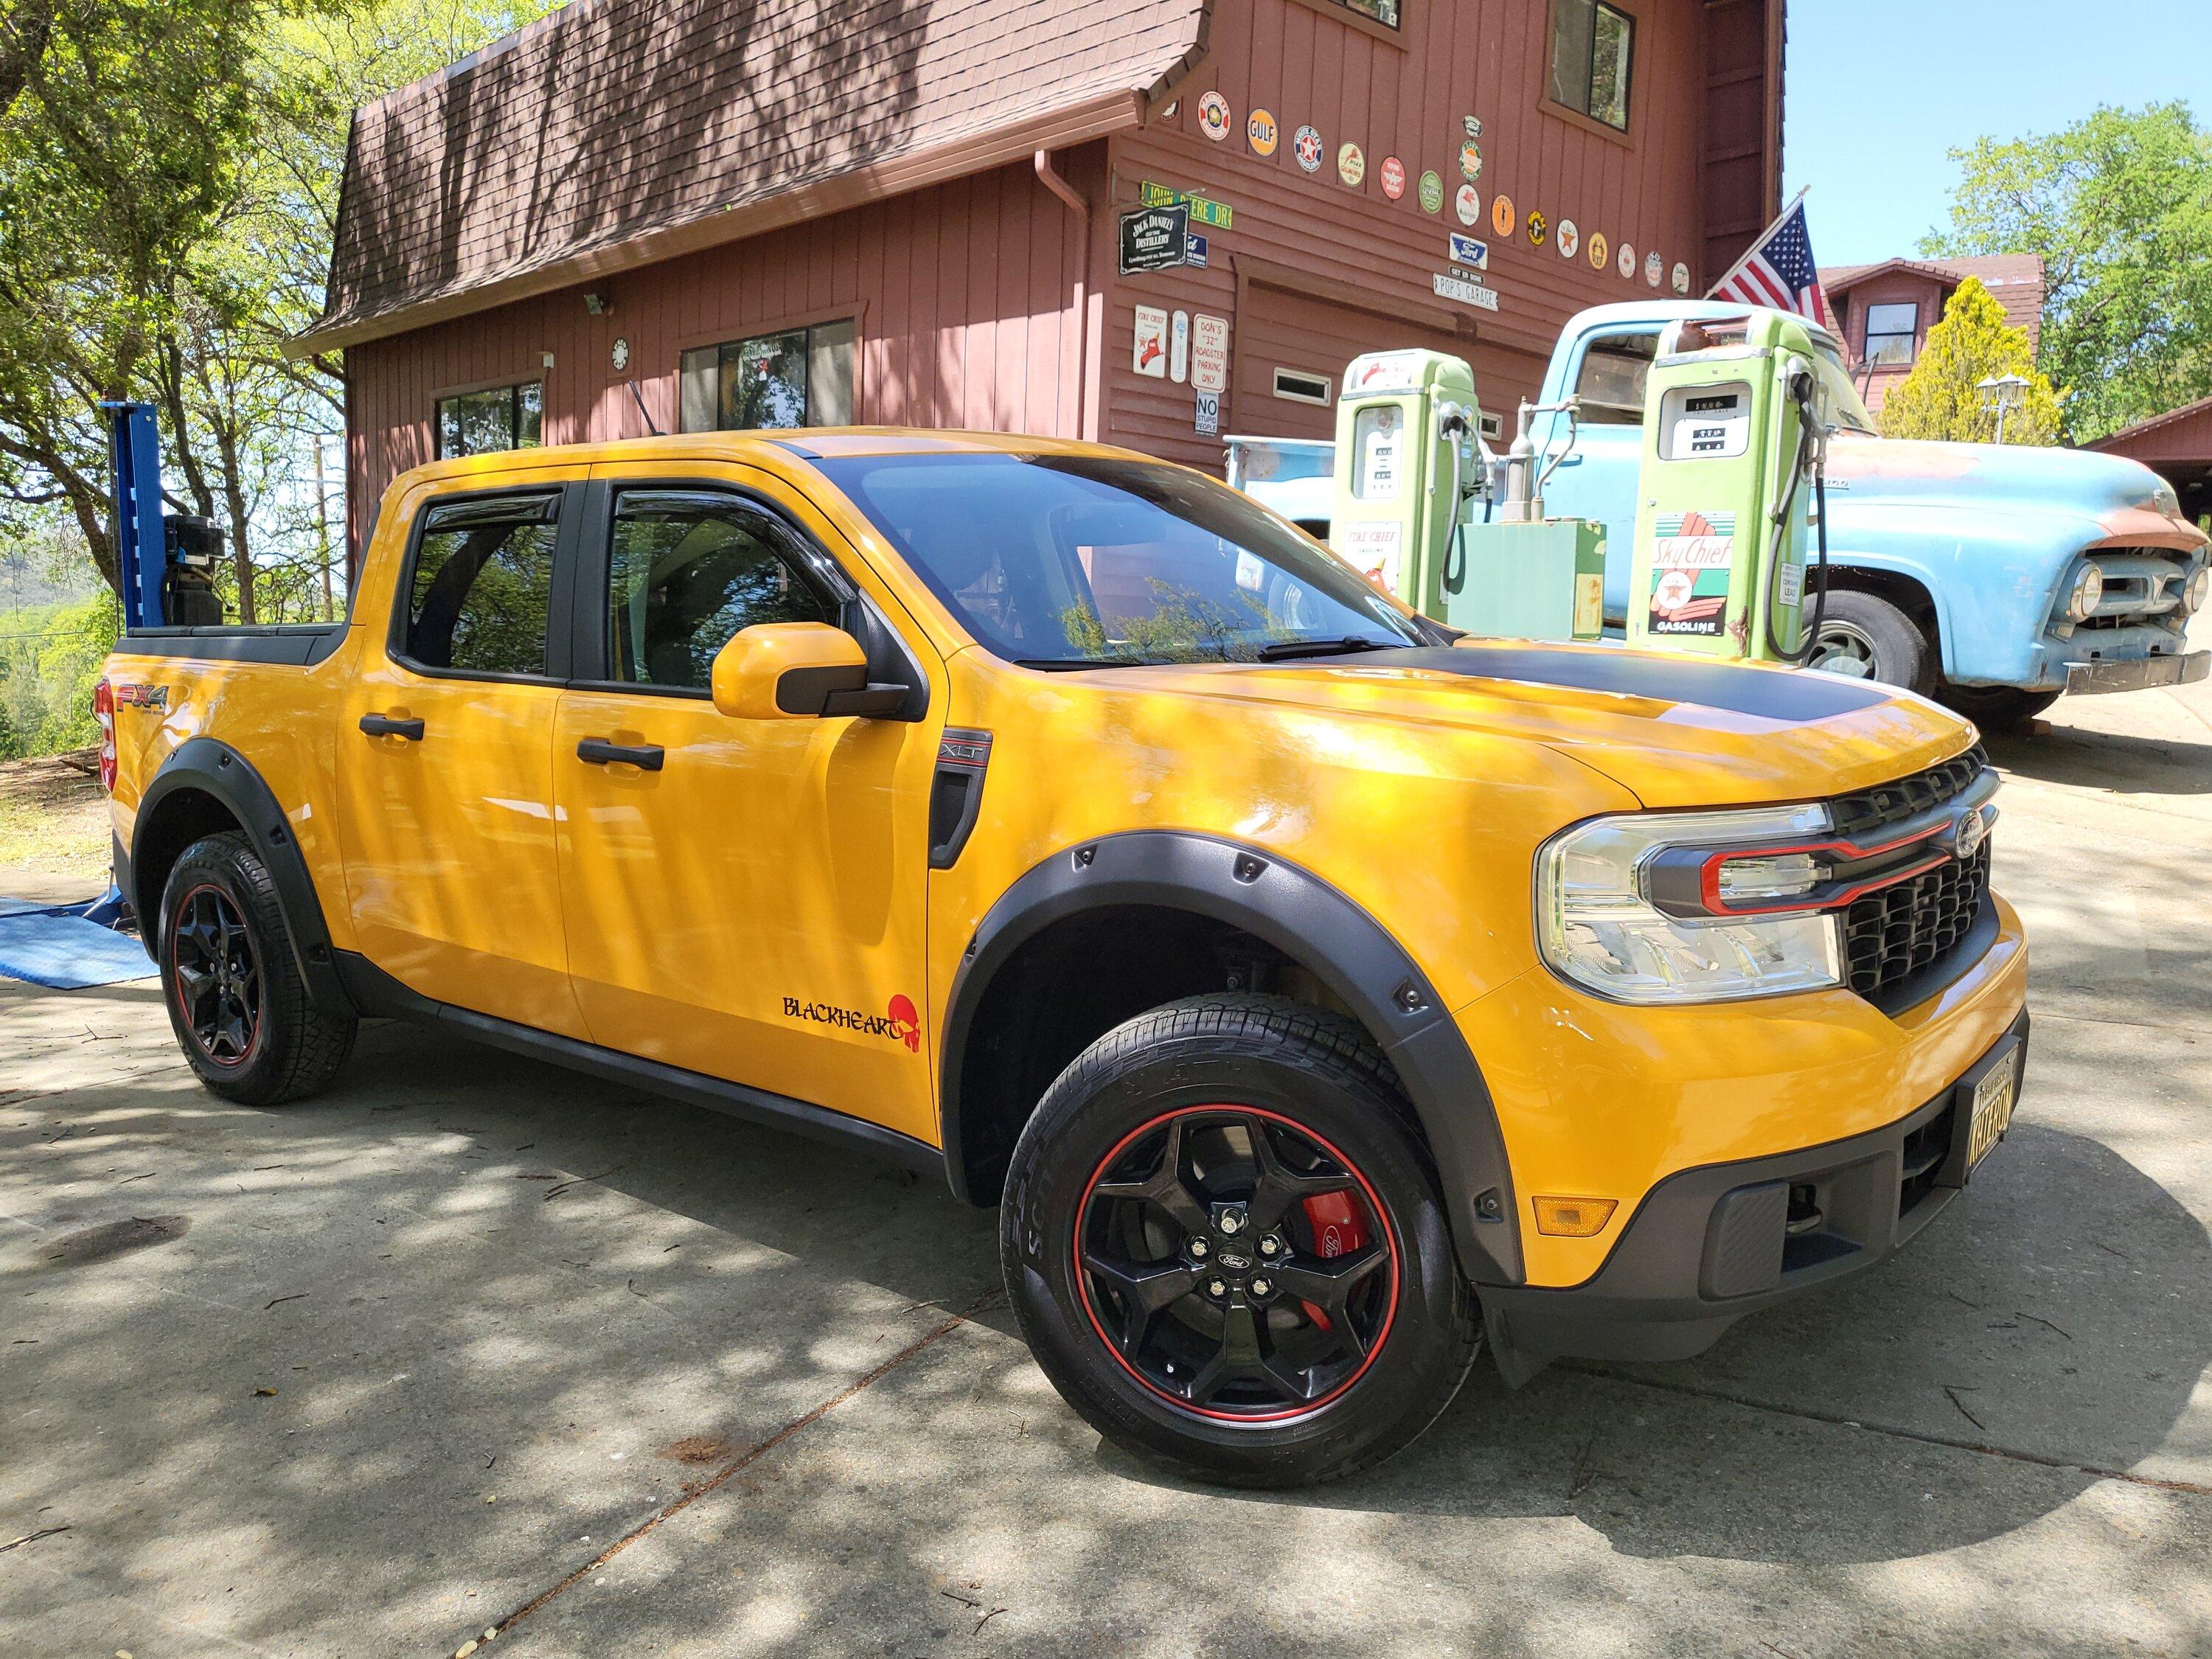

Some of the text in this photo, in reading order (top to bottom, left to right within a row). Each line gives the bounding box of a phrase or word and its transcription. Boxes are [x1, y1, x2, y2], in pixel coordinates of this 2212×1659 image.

[1250, 120, 1274, 143] GULF
[1215, 206, 1228, 226] DR
[1133, 219, 1149, 237] JACK
[1135, 233, 1170, 249] DISTILLERY
[1461, 241, 1479, 259] Ford
[1440, 278, 1494, 307] POP'S GARAGE
[1200, 321, 1222, 335] DON'S
[1195, 347, 1224, 360] ROADSTER
[1197, 360, 1221, 372] PARKING
[1201, 374, 1216, 385] ONLY
[1197, 397, 1217, 416] NO
[1196, 422, 1216, 431] PEOPLE
[1197, 415, 1217, 424] STUPID
[1348, 531, 1397, 542] FIRE CHIEF
[1653, 538, 1734, 568] Sky Chief
[1784, 588, 1797, 597] LEAD
[1657, 621, 1716, 633] GASOLINE
[116, 684, 169, 712] FX4
[939, 744, 983, 759] XLT
[1222, 1255, 1245, 1267] Ford
